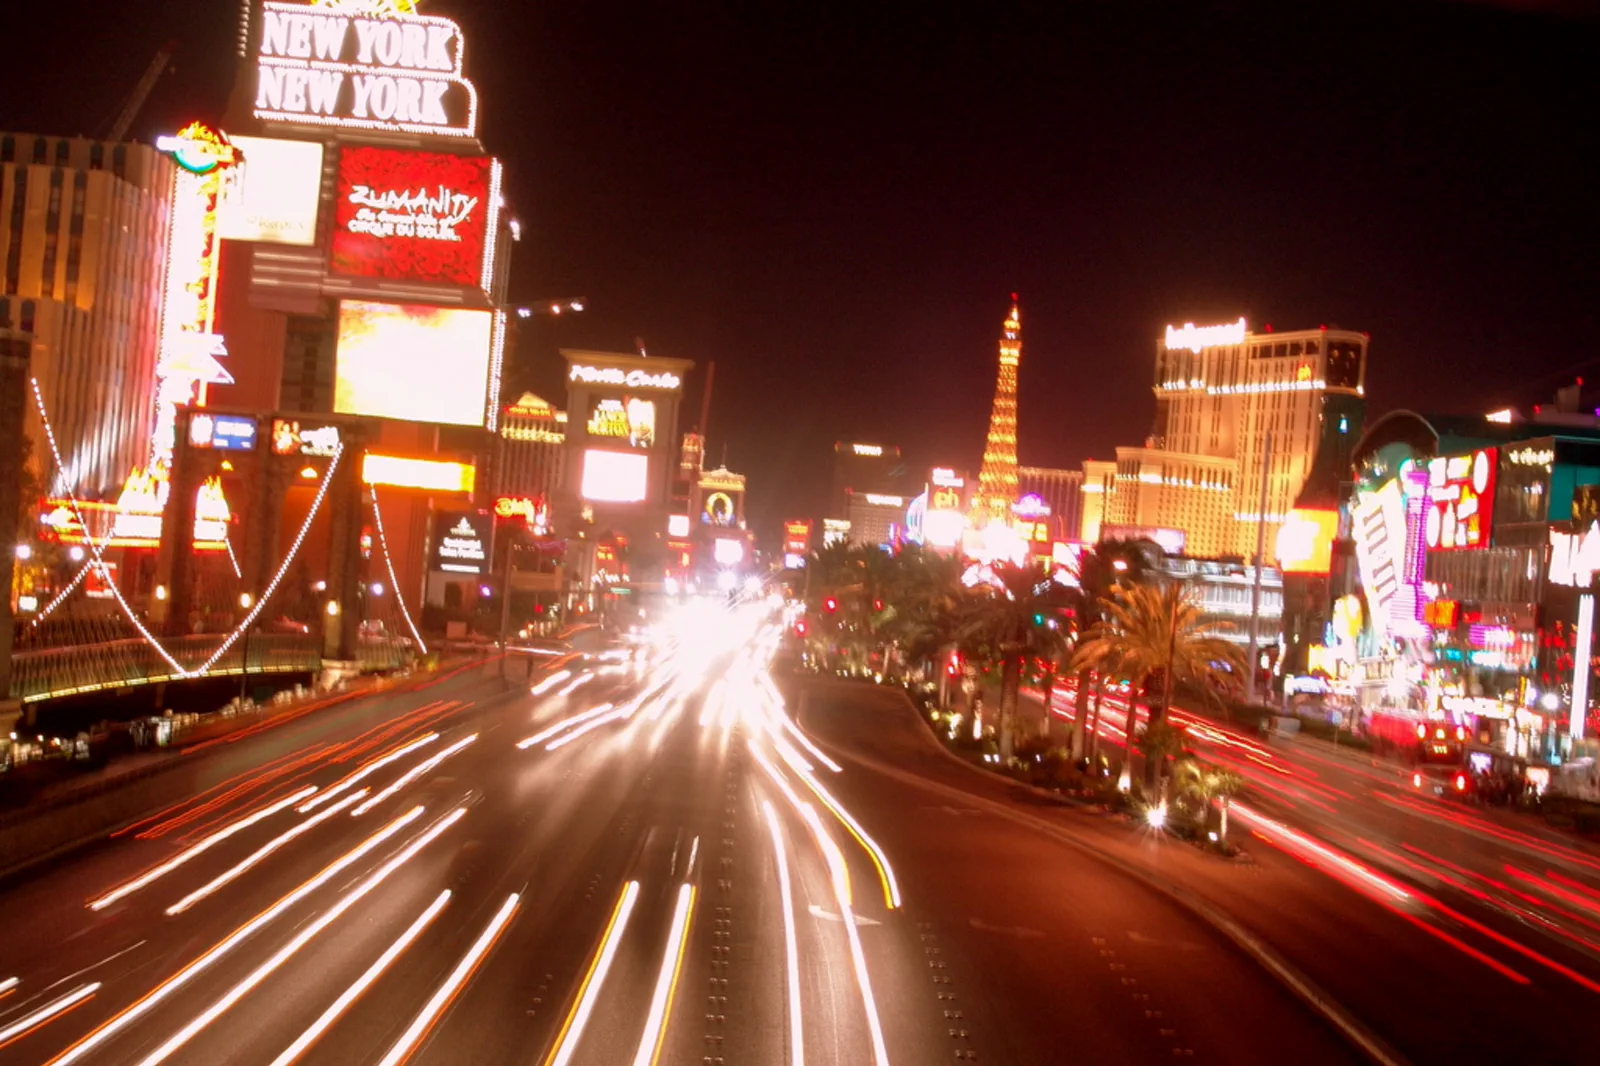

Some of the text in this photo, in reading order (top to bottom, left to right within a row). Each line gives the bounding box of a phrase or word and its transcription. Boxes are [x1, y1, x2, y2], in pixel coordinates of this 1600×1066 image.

[261, 11, 453, 71] NEW YORK
[256, 66, 449, 124] NEW YORK
[349, 184, 478, 226] ZUMANITY
